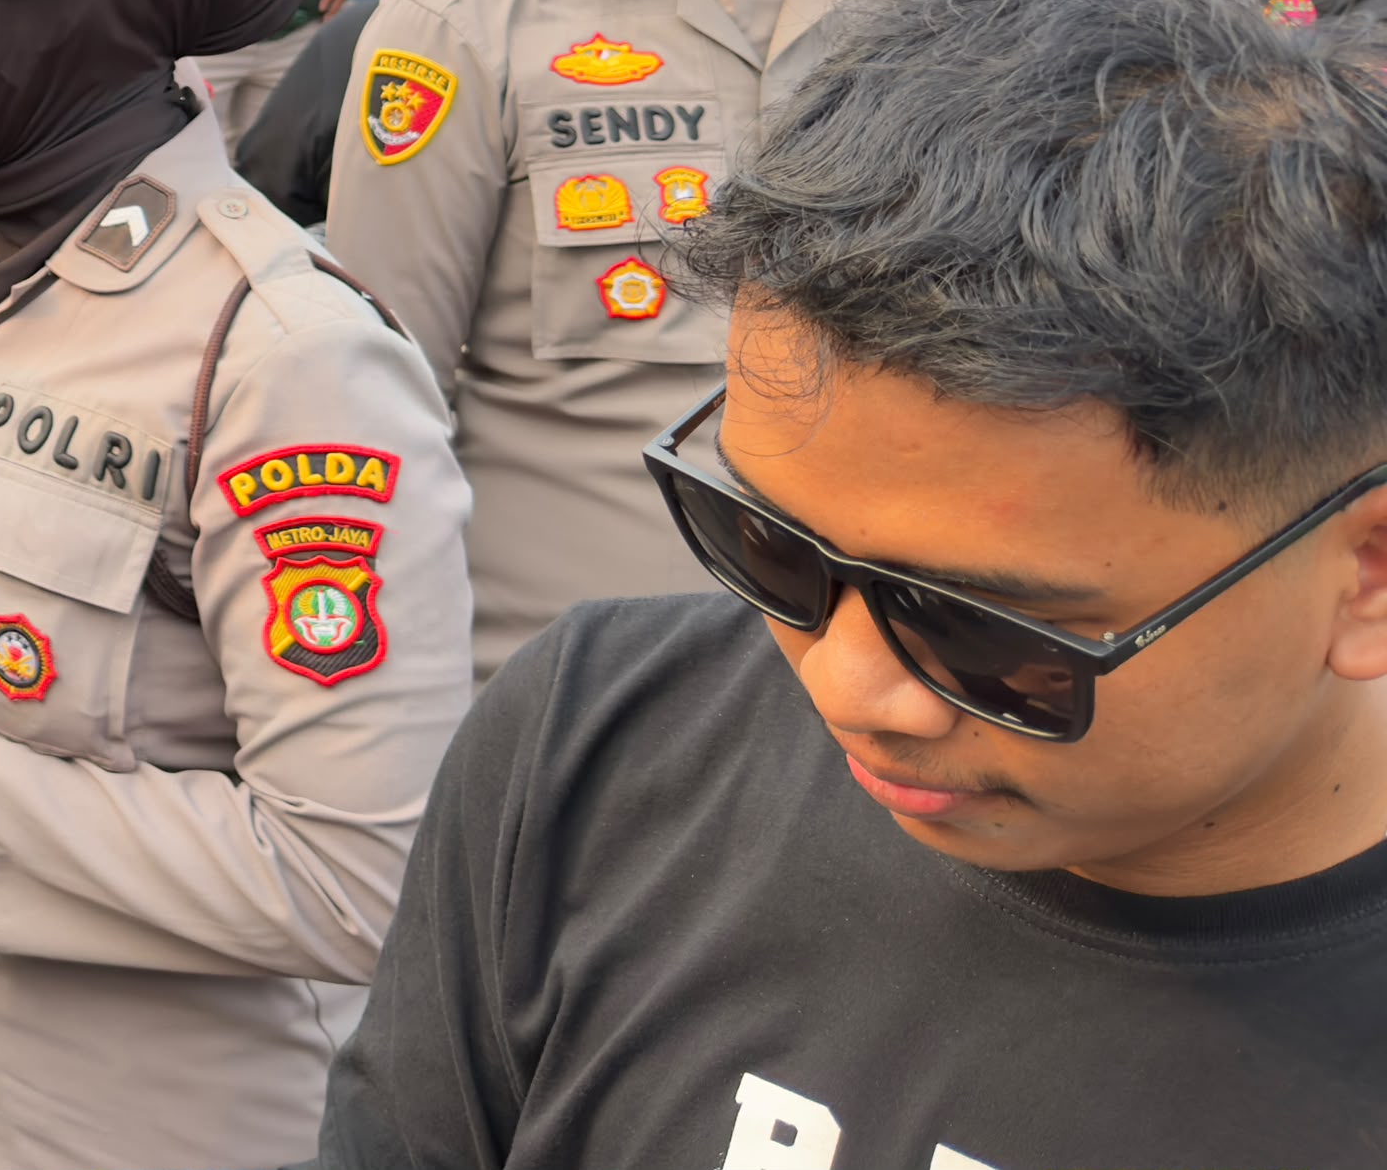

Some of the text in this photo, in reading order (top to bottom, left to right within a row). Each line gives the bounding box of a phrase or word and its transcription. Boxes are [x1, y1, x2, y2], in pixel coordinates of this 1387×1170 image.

[379, 55, 448, 88] RESERSE
[547, 104, 704, 148] SENDY
[229, 452, 387, 507] POLDA
[266, 526, 372, 551] METRO JAYA
